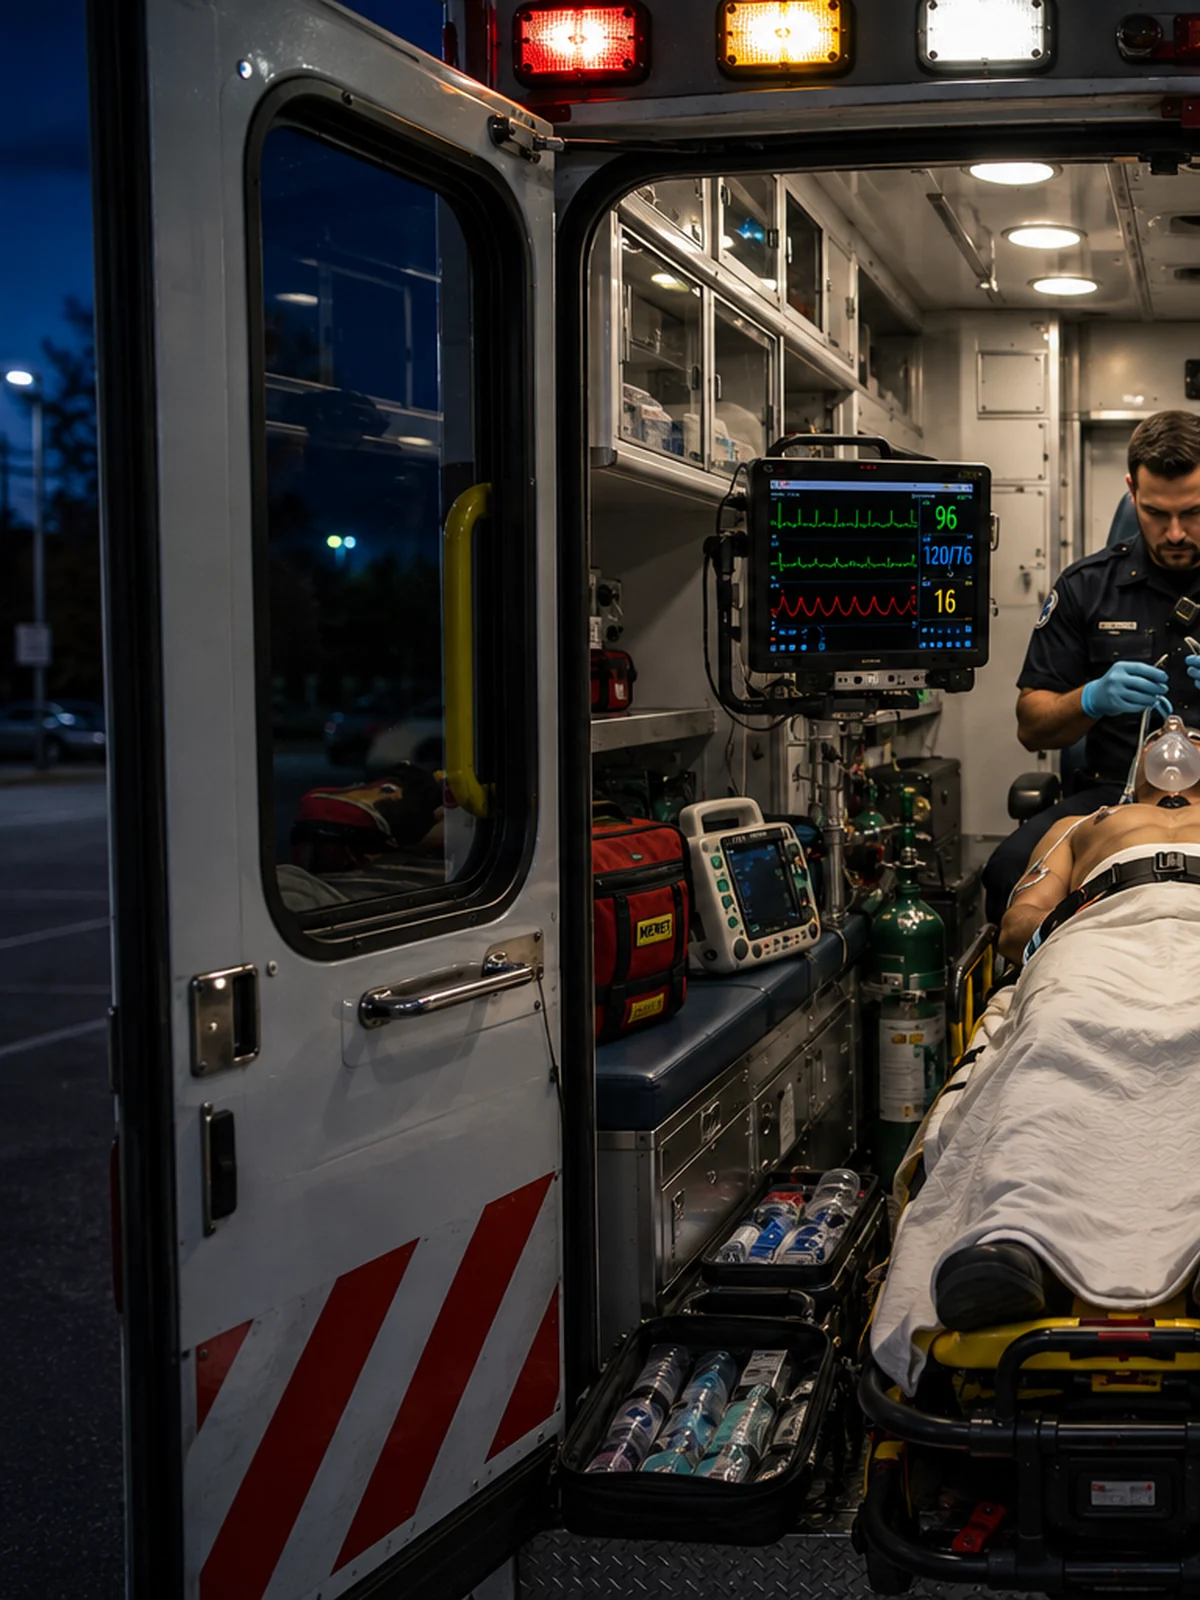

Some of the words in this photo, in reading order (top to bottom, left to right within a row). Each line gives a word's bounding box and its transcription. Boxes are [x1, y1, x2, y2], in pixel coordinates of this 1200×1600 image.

[935, 505, 957, 530] 96
[923, 545, 972, 567] 120/76
[934, 588, 957, 614] 16
